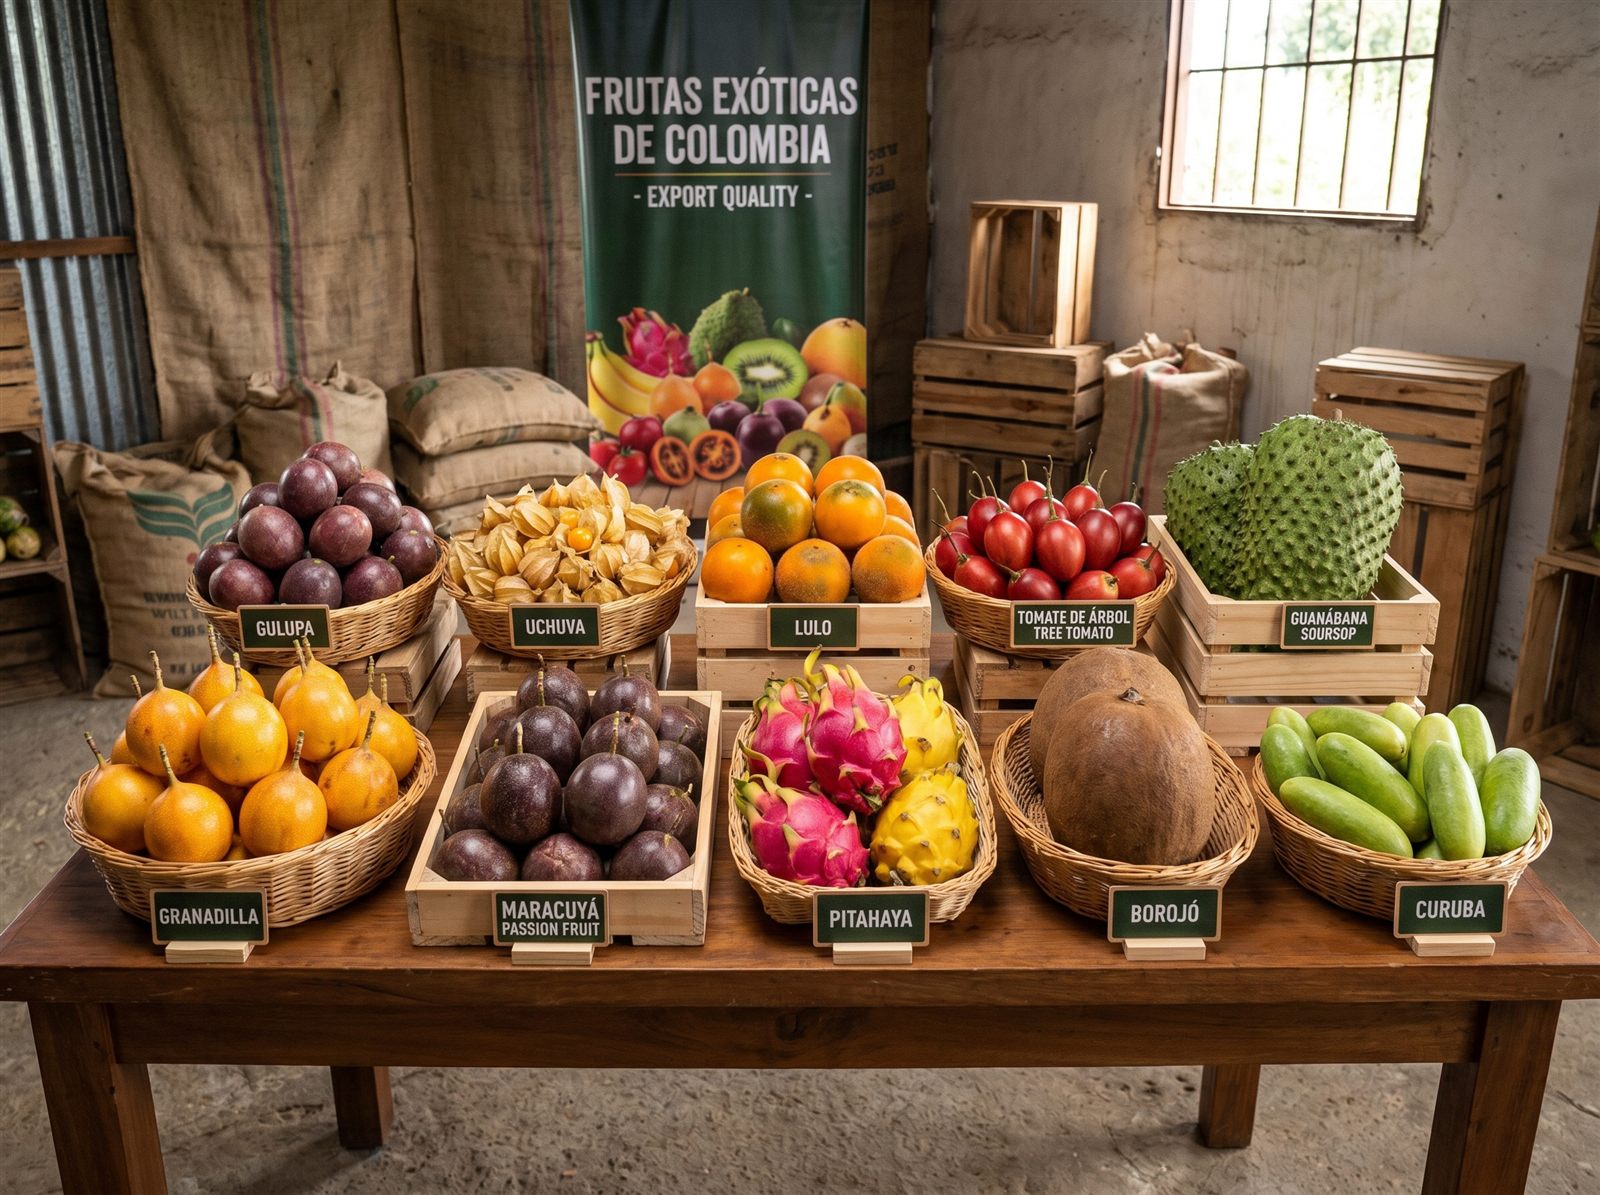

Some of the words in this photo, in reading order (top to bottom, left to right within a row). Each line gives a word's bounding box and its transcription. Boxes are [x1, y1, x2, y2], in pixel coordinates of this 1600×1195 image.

[585, 76, 703, 115] FRUTAS
[713, 66, 858, 115] EXÓTICAS
[613, 124, 656, 165] DE
[665, 124, 832, 165] COLOMBIA
[647, 185, 718, 208] EXPORT
[722, 185, 799, 211] QUALITY
[1017, 610, 1067, 625] TOMATE
[1070, 610, 1086, 624] DE
[1088, 606, 1131, 624] ÁRBOL
[1290, 607, 1368, 625] GUANÁBANA
[256, 620, 315, 637] GULUPA
[525, 618, 586, 635] UCHUVA
[795, 619, 832, 636] LULO
[1033, 626, 1063, 640] TREE
[1065, 626, 1114, 640] TOMATO
[1300, 627, 1357, 641] SOURSOP
[159, 907, 259, 925] GRANADILLA
[502, 897, 600, 920] MARACUYÁ
[1131, 899, 1199, 923] BOROJÓ
[1416, 899, 1486, 919] CURUBA
[829, 909, 913, 928] PITAHAYA
[502, 922, 559, 936] PASSION
[562, 922, 600, 937] FRUIT
